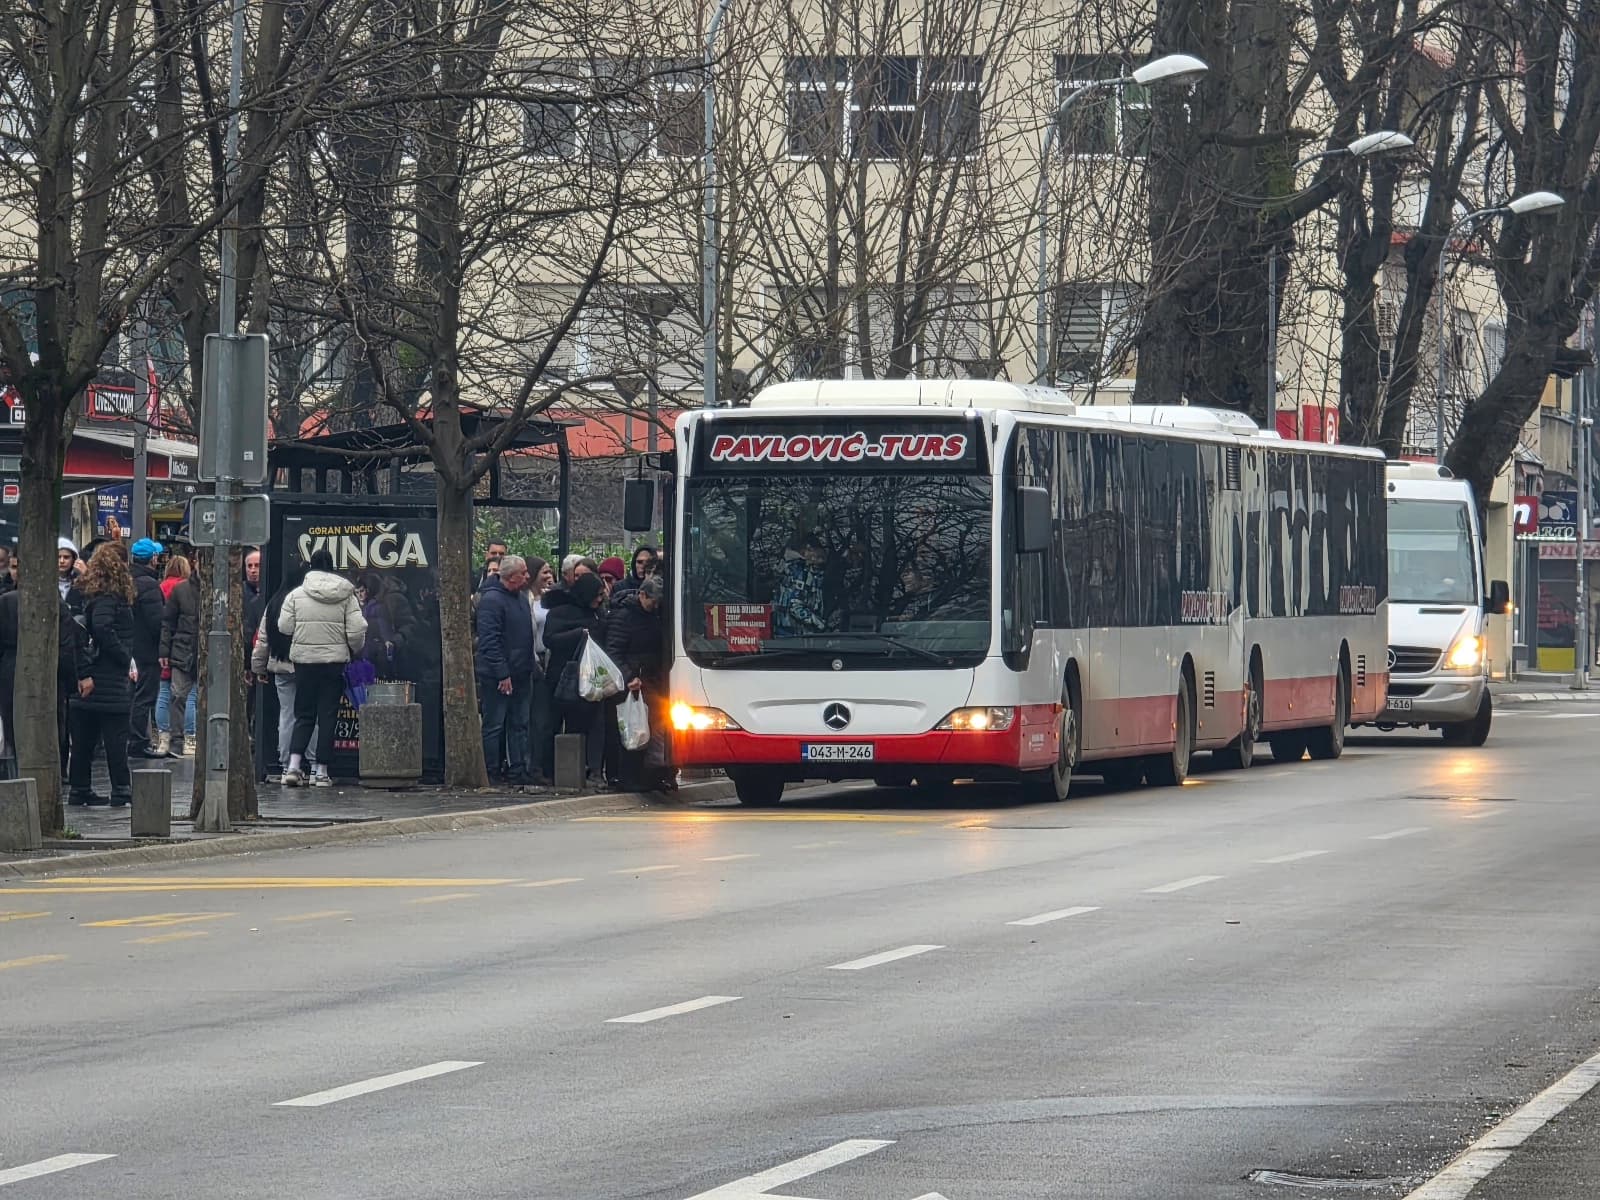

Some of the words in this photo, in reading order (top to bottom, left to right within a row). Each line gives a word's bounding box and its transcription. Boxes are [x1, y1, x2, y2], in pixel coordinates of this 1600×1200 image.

[710, 431, 967, 461] PAVLOVIĆ-TURS
[298, 522, 428, 569] VINČA
[309, 527, 341, 535] GORAN
[711, 605, 719, 636] 1
[810, 746, 871, 759] 043-M-246
